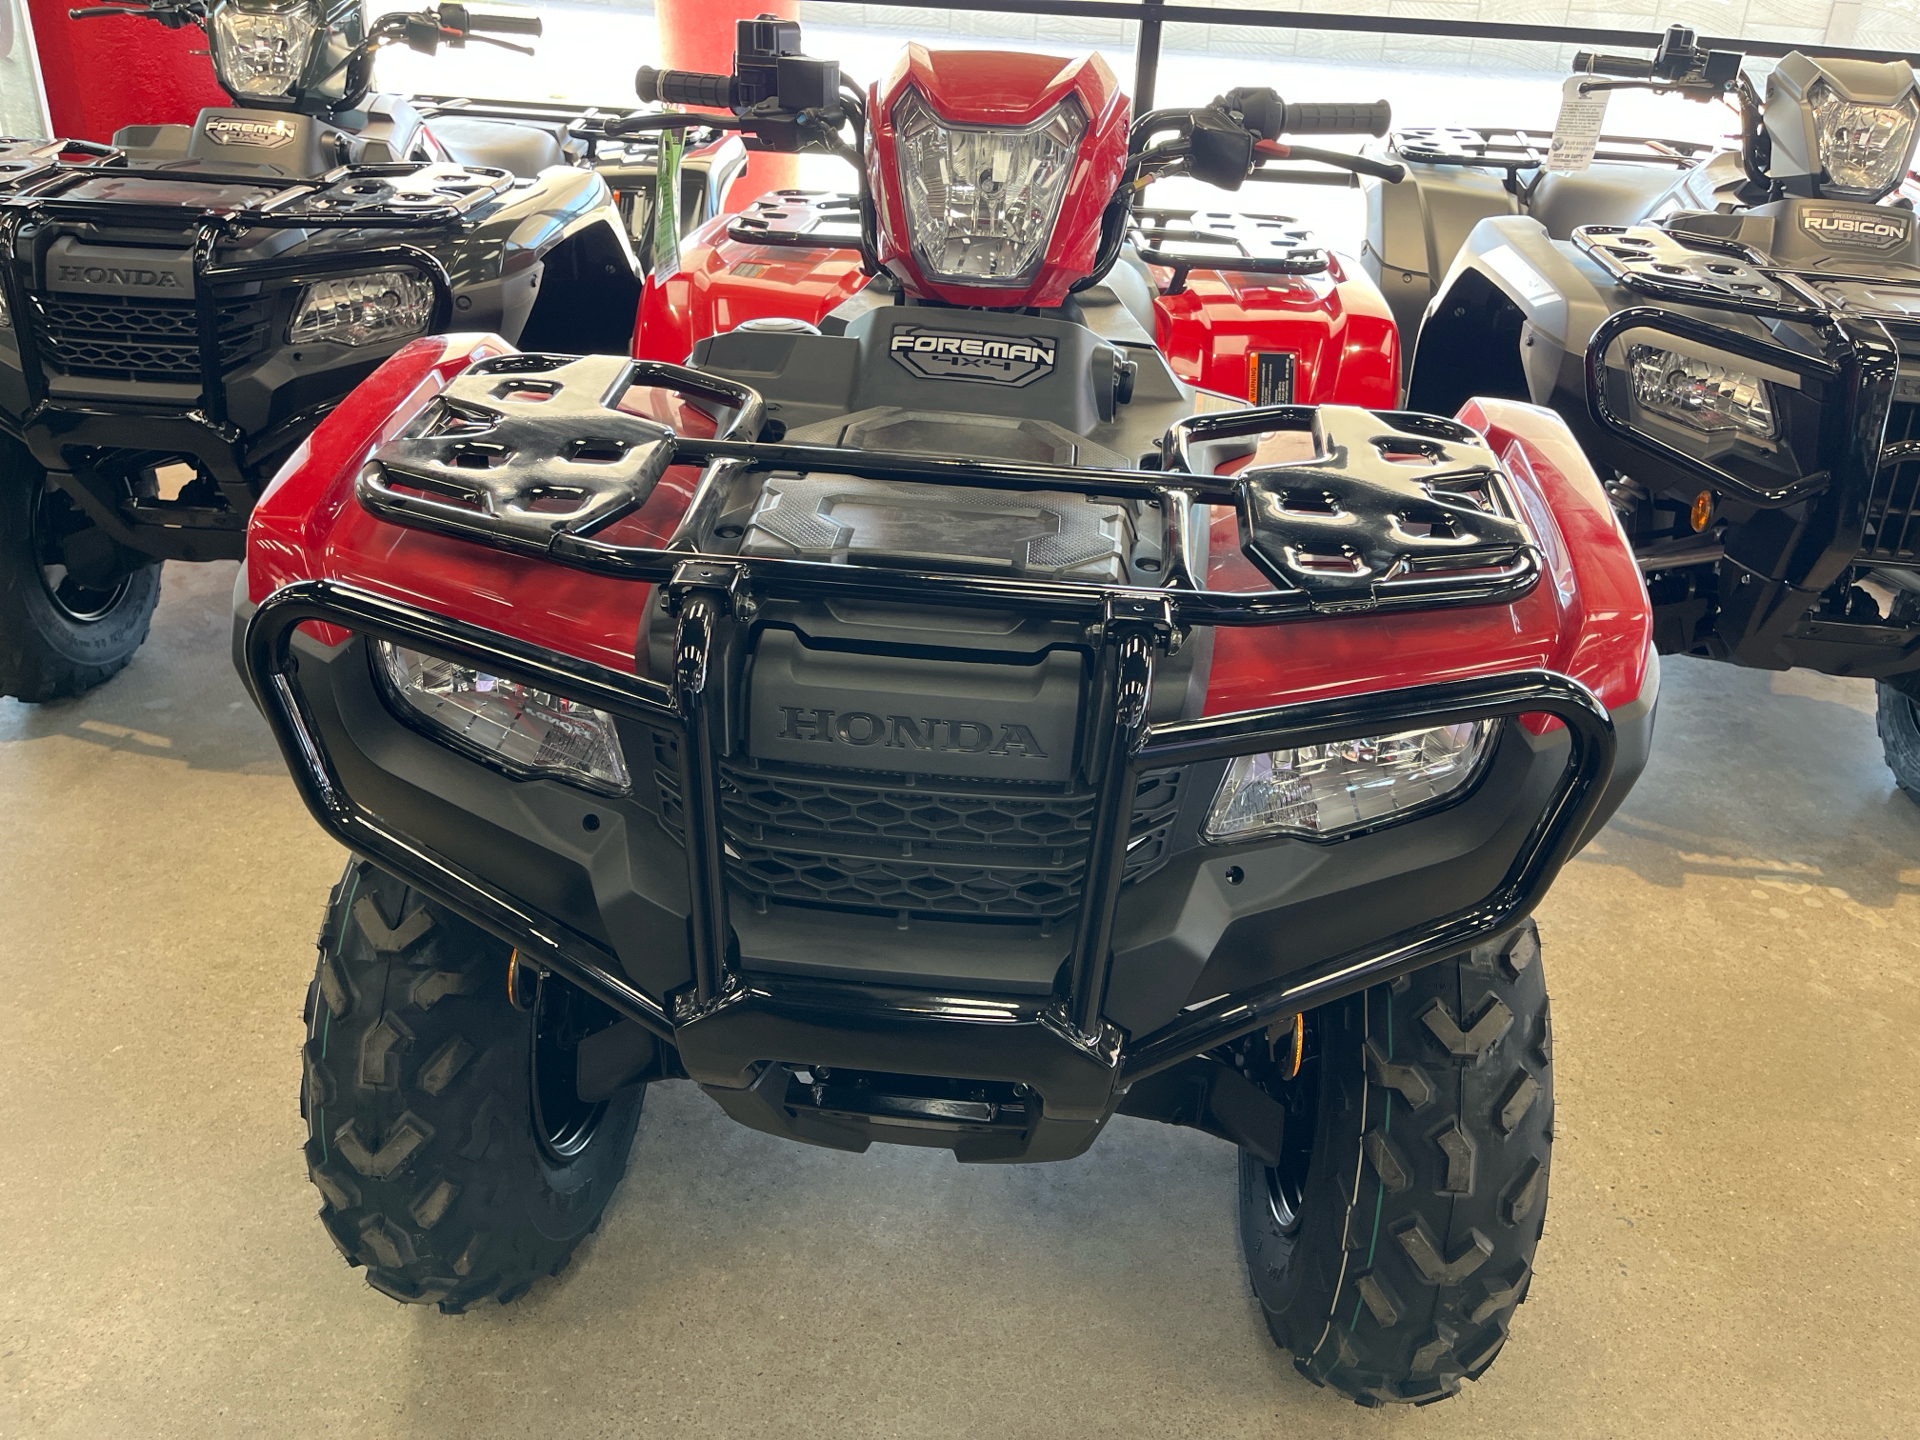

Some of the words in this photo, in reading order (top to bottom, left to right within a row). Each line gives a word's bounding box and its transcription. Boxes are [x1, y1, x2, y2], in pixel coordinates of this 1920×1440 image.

[205, 121, 295, 138] FOREMAN
[1804, 217, 1904, 239] RUBICON
[58, 265, 185, 288] HONDA
[891, 335, 1054, 365] FOREMAN
[931, 355, 1011, 371] 4X4
[777, 706, 1048, 758] HONDA
